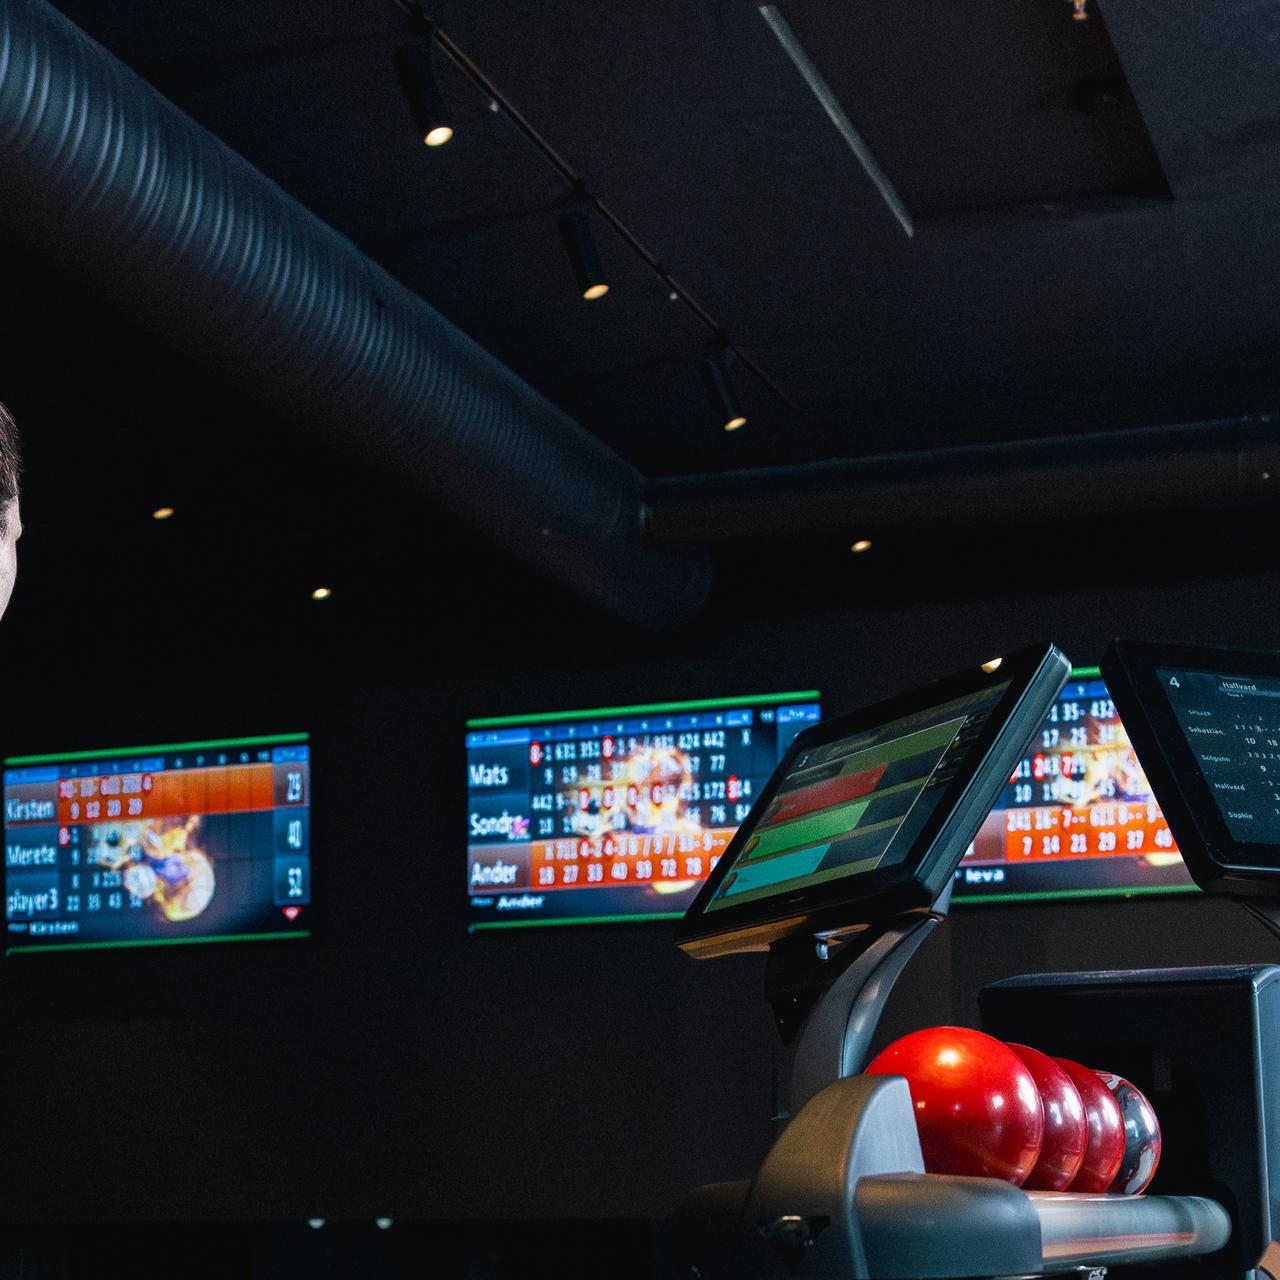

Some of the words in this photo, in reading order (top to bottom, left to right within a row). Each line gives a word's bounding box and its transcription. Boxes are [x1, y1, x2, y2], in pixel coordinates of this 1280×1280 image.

[1169, 676, 1180, 689] 4
[1222, 682, 1257, 691] Hallvard
[1062, 702, 1086, 721] 35-
[742, 728, 751, 746] X
[1042, 729, 1059, 748] 17
[1071, 727, 1088, 745] 25
[1188, 726, 1224, 735] Sebastian
[1245, 737, 1256, 745] 10
[1267, 739, 1278, 747] 18
[469, 763, 509, 787] Mats
[544, 767, 554, 784] 9
[710, 754, 726, 771] 77
[1015, 784, 1032, 802] 10
[1215, 783, 1246, 791] Hallvard
[71, 802, 79, 819] 9
[710, 805, 726, 823] 76
[1228, 811, 1253, 820] Sophie
[1023, 836, 1032, 855] 7
[1042, 835, 1060, 855] 14
[1070, 833, 1087, 853] 21
[1098, 831, 1116, 851] 29
[1126, 829, 1144, 850] 37
[1154, 828, 1173, 848] 46
[6, 844, 57, 867] Merete
[470, 859, 518, 884] Ander
[66, 895, 81, 912] 22
[287, 866, 303, 898] 52
[6, 887, 59, 920] player3
[496, 893, 545, 911] Ander
[29, 921, 79, 935] Kirsten
